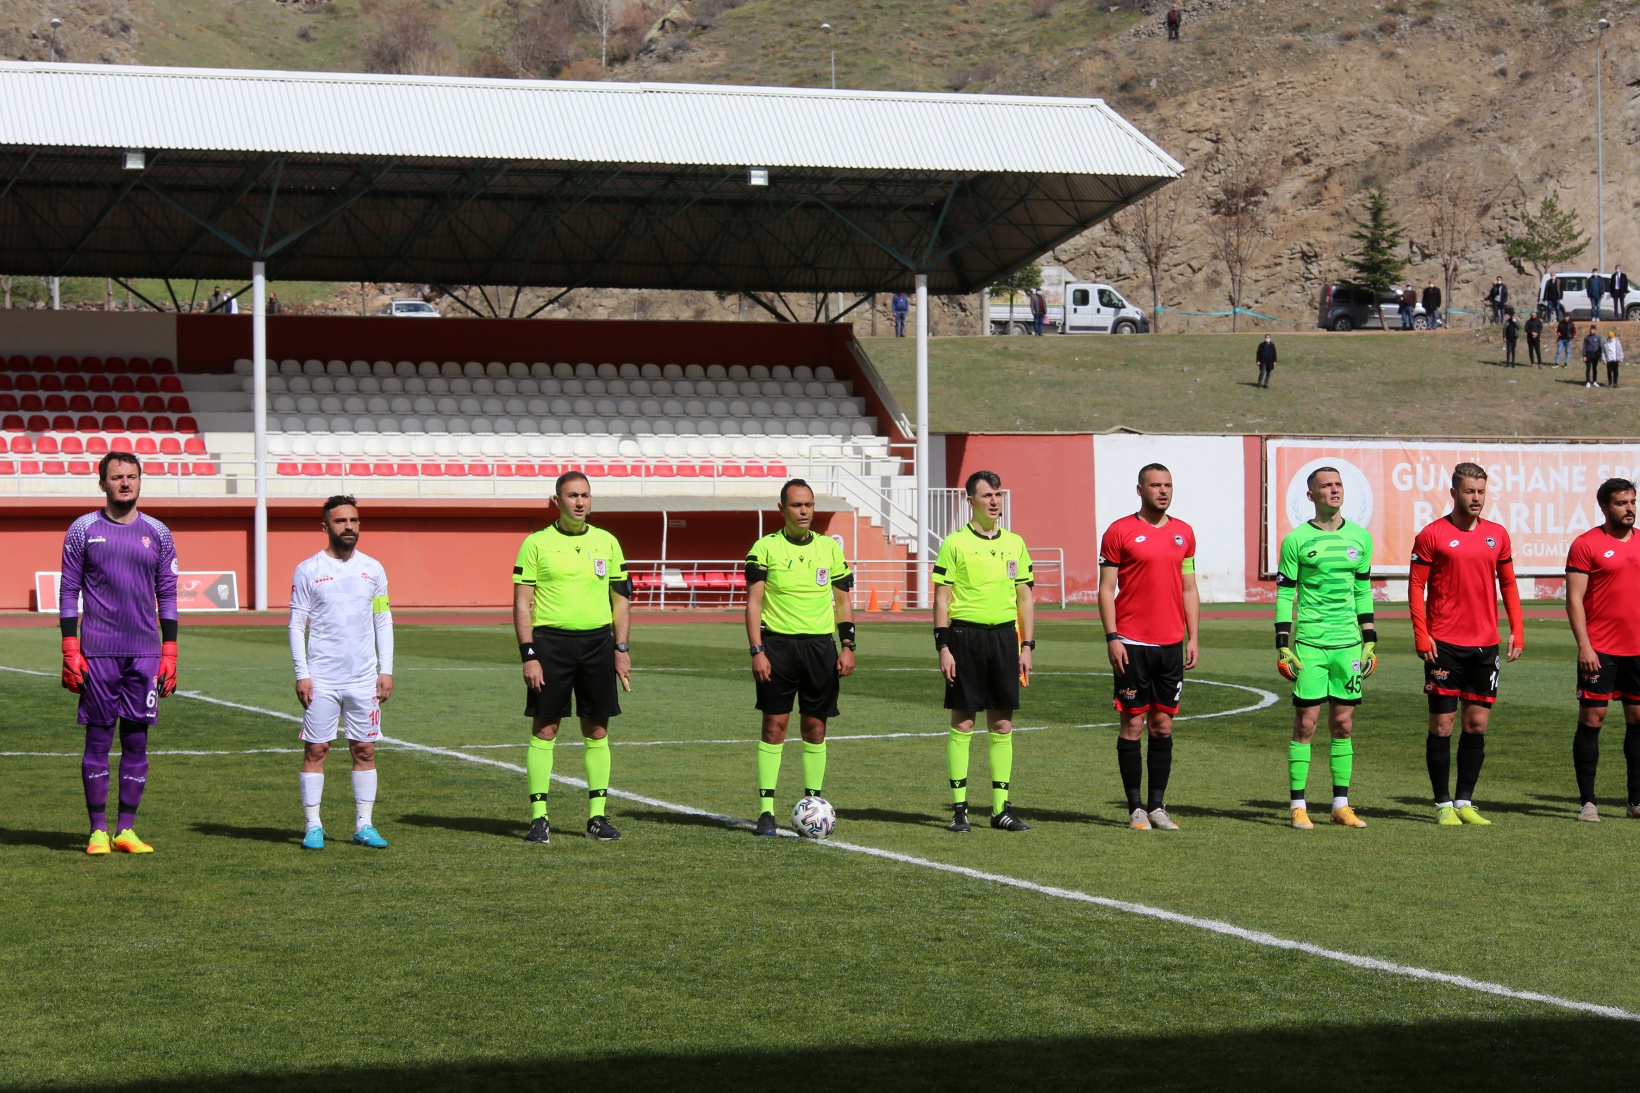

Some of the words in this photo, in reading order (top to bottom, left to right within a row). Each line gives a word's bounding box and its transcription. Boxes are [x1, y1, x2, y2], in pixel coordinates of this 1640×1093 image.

[1392, 456, 1587, 500] GÜŞHANE
[1521, 539, 1571, 557] GÜMÜ
[1344, 674, 1361, 694] 45
[369, 709, 380, 726] 10
